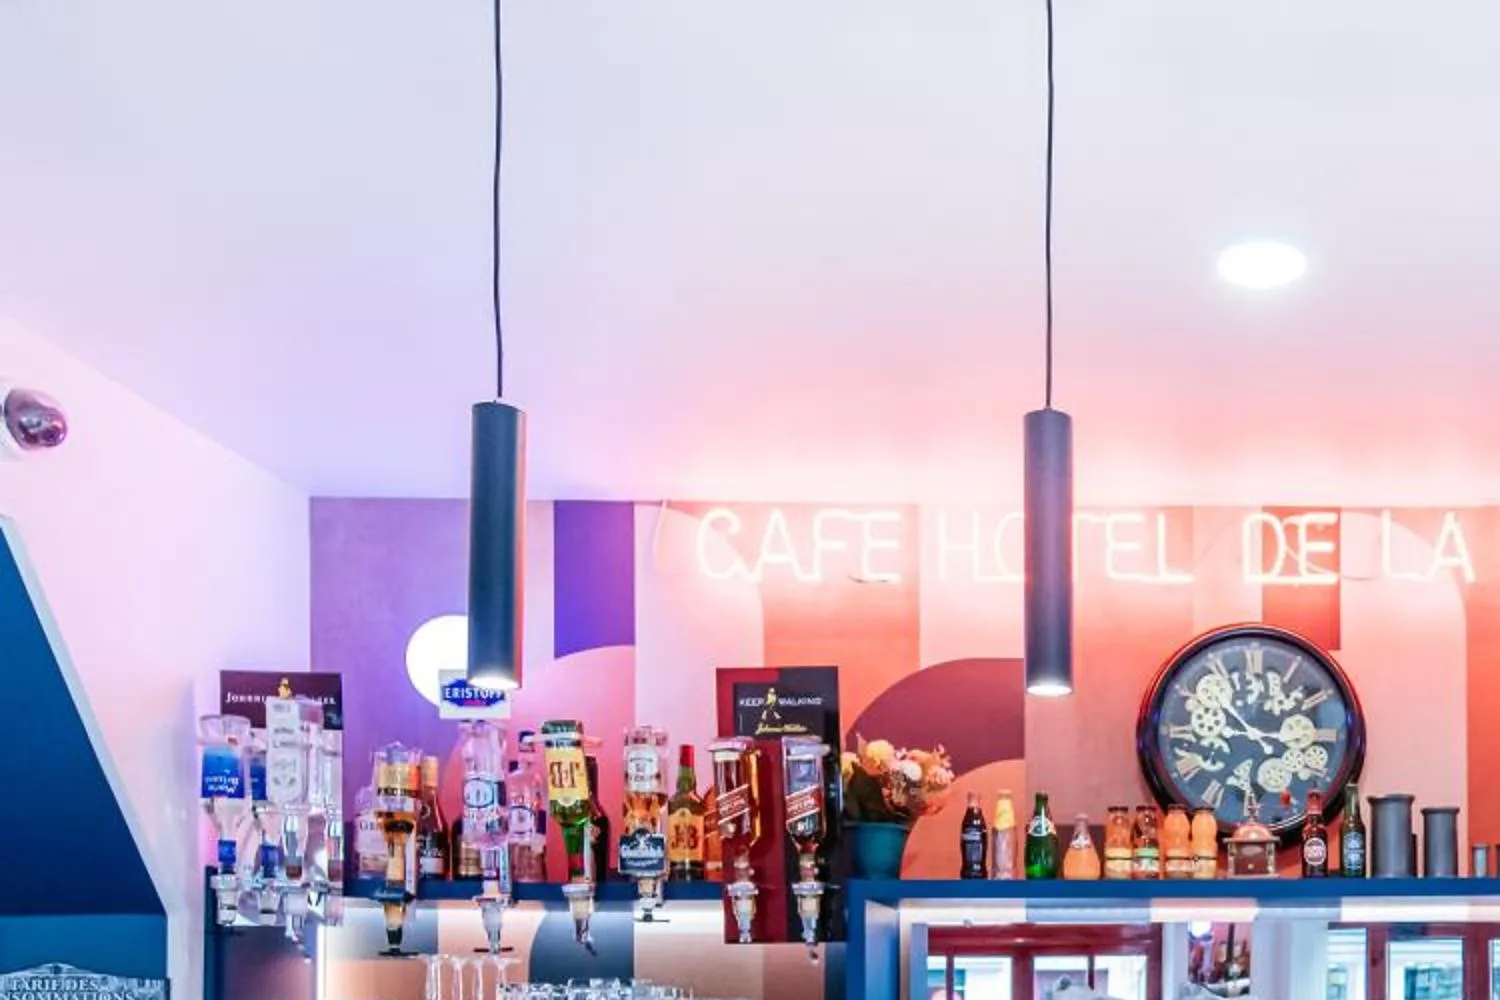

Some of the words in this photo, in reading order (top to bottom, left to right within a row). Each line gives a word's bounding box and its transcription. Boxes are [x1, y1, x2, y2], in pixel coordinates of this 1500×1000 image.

[696, 508, 901, 585] CAFE
[1242, 512, 1340, 585] DE
[1381, 509, 1478, 584] LA
[225, 692, 266, 703] JOHNNI
[740, 697, 764, 706] KEEP
[779, 697, 822, 706] WALKING
[671, 823, 700, 850] J&B
[12, 979, 60, 991] TARIF
[65, 979, 99, 991] DES
